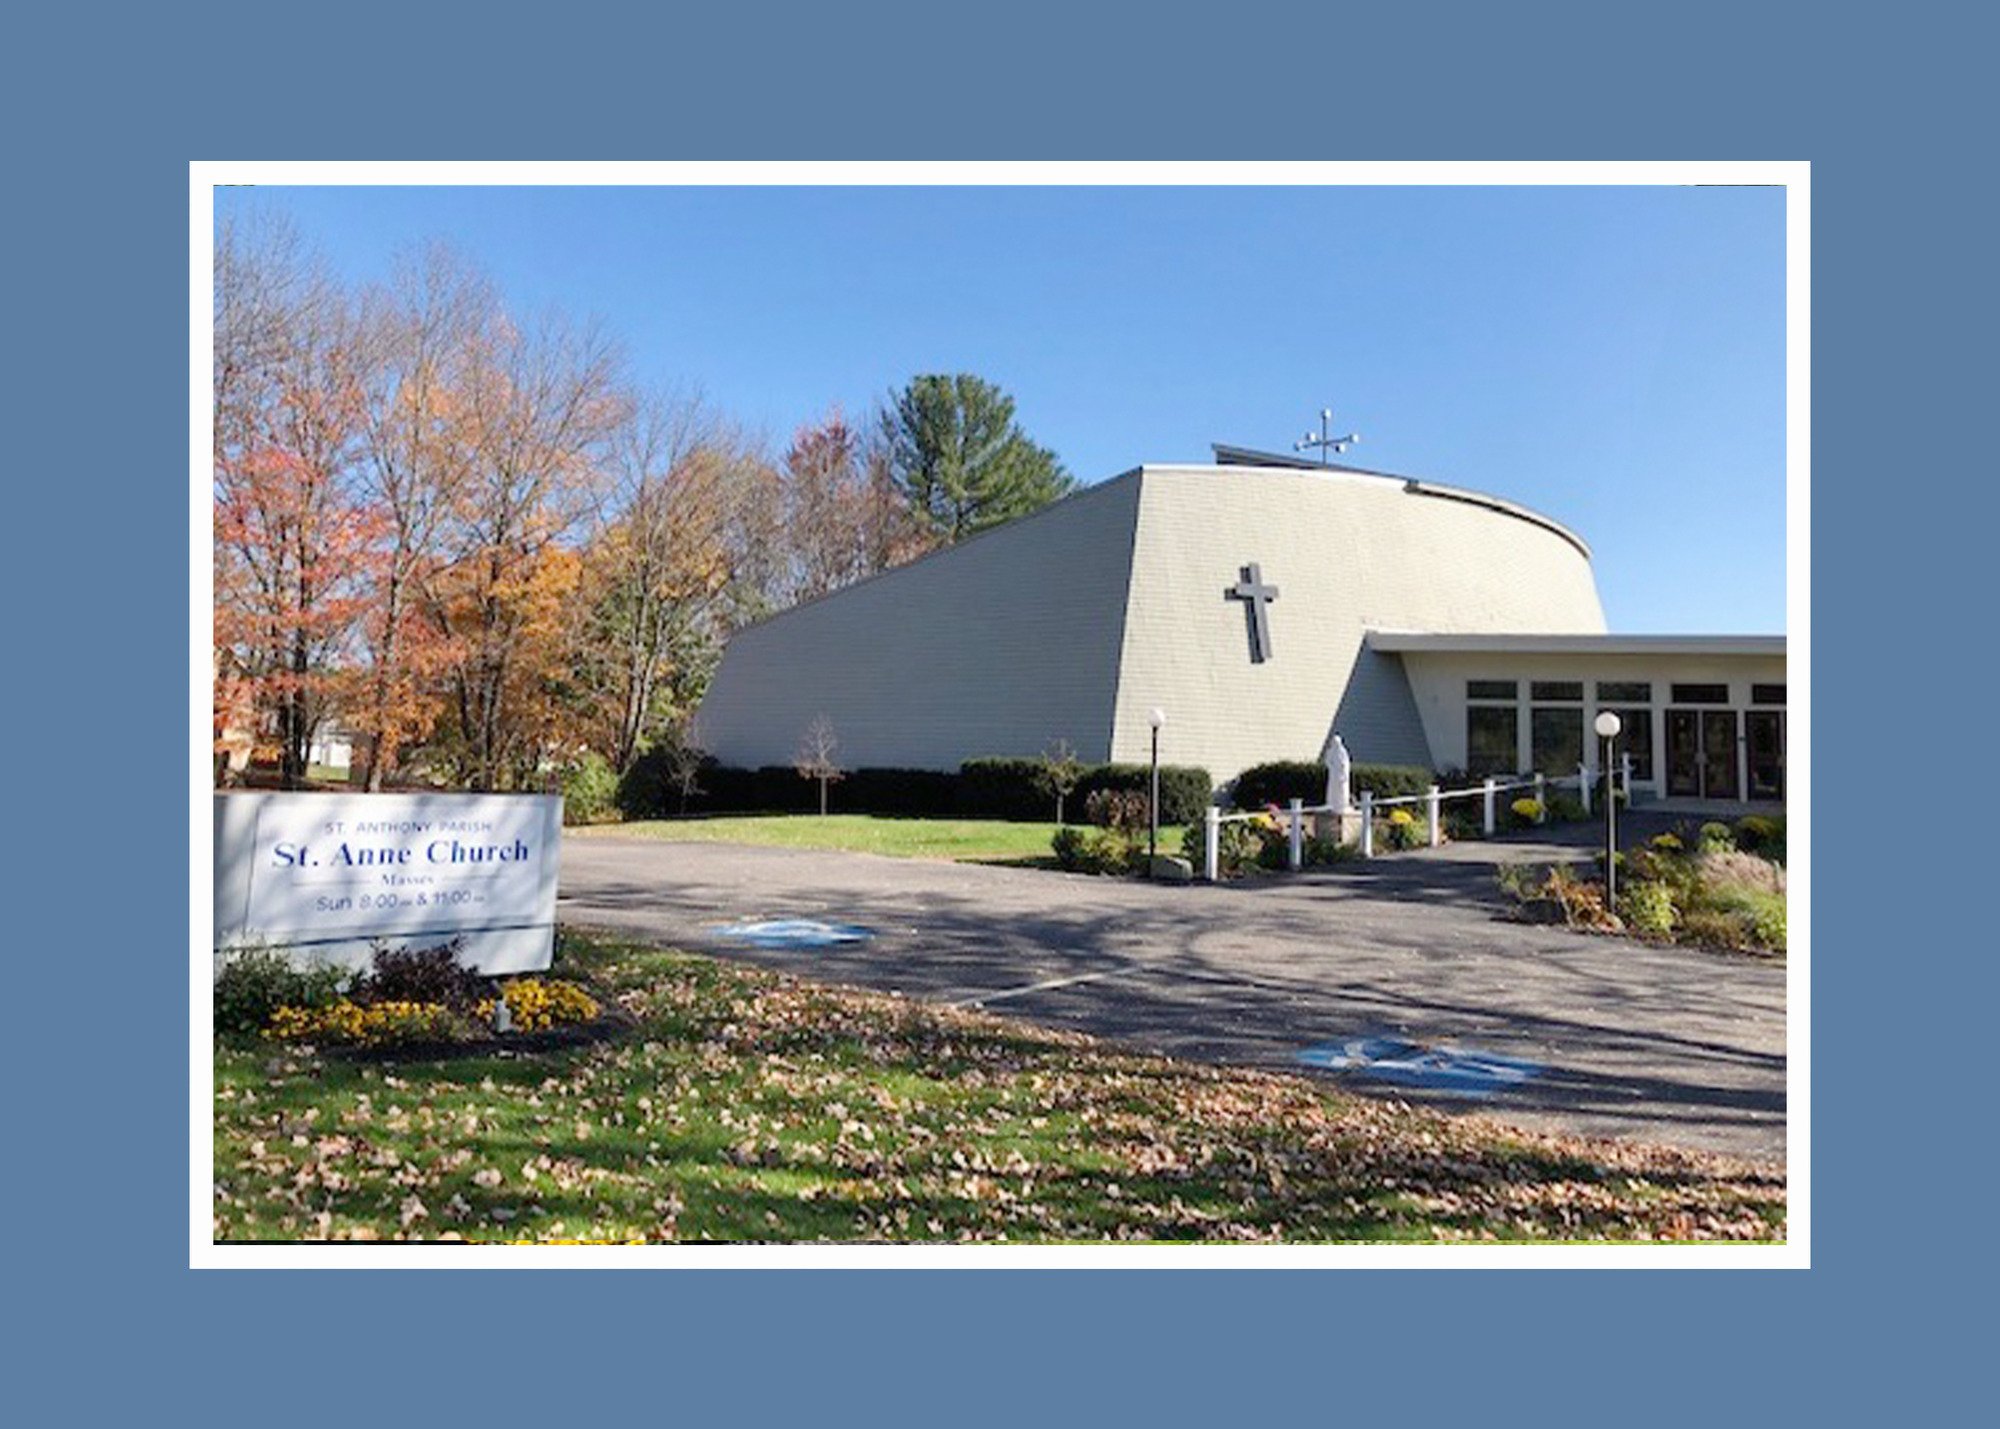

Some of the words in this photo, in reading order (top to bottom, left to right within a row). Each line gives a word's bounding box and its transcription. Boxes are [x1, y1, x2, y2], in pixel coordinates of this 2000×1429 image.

[356, 821, 432, 834] ANTHONY
[440, 821, 492, 832] PARISH
[272, 842, 319, 867] St.
[329, 841, 412, 866] Anne
[427, 838, 528, 863] Church
[382, 873, 434, 886] Masses
[315, 895, 353, 912] Sun
[417, 891, 427, 906] &
